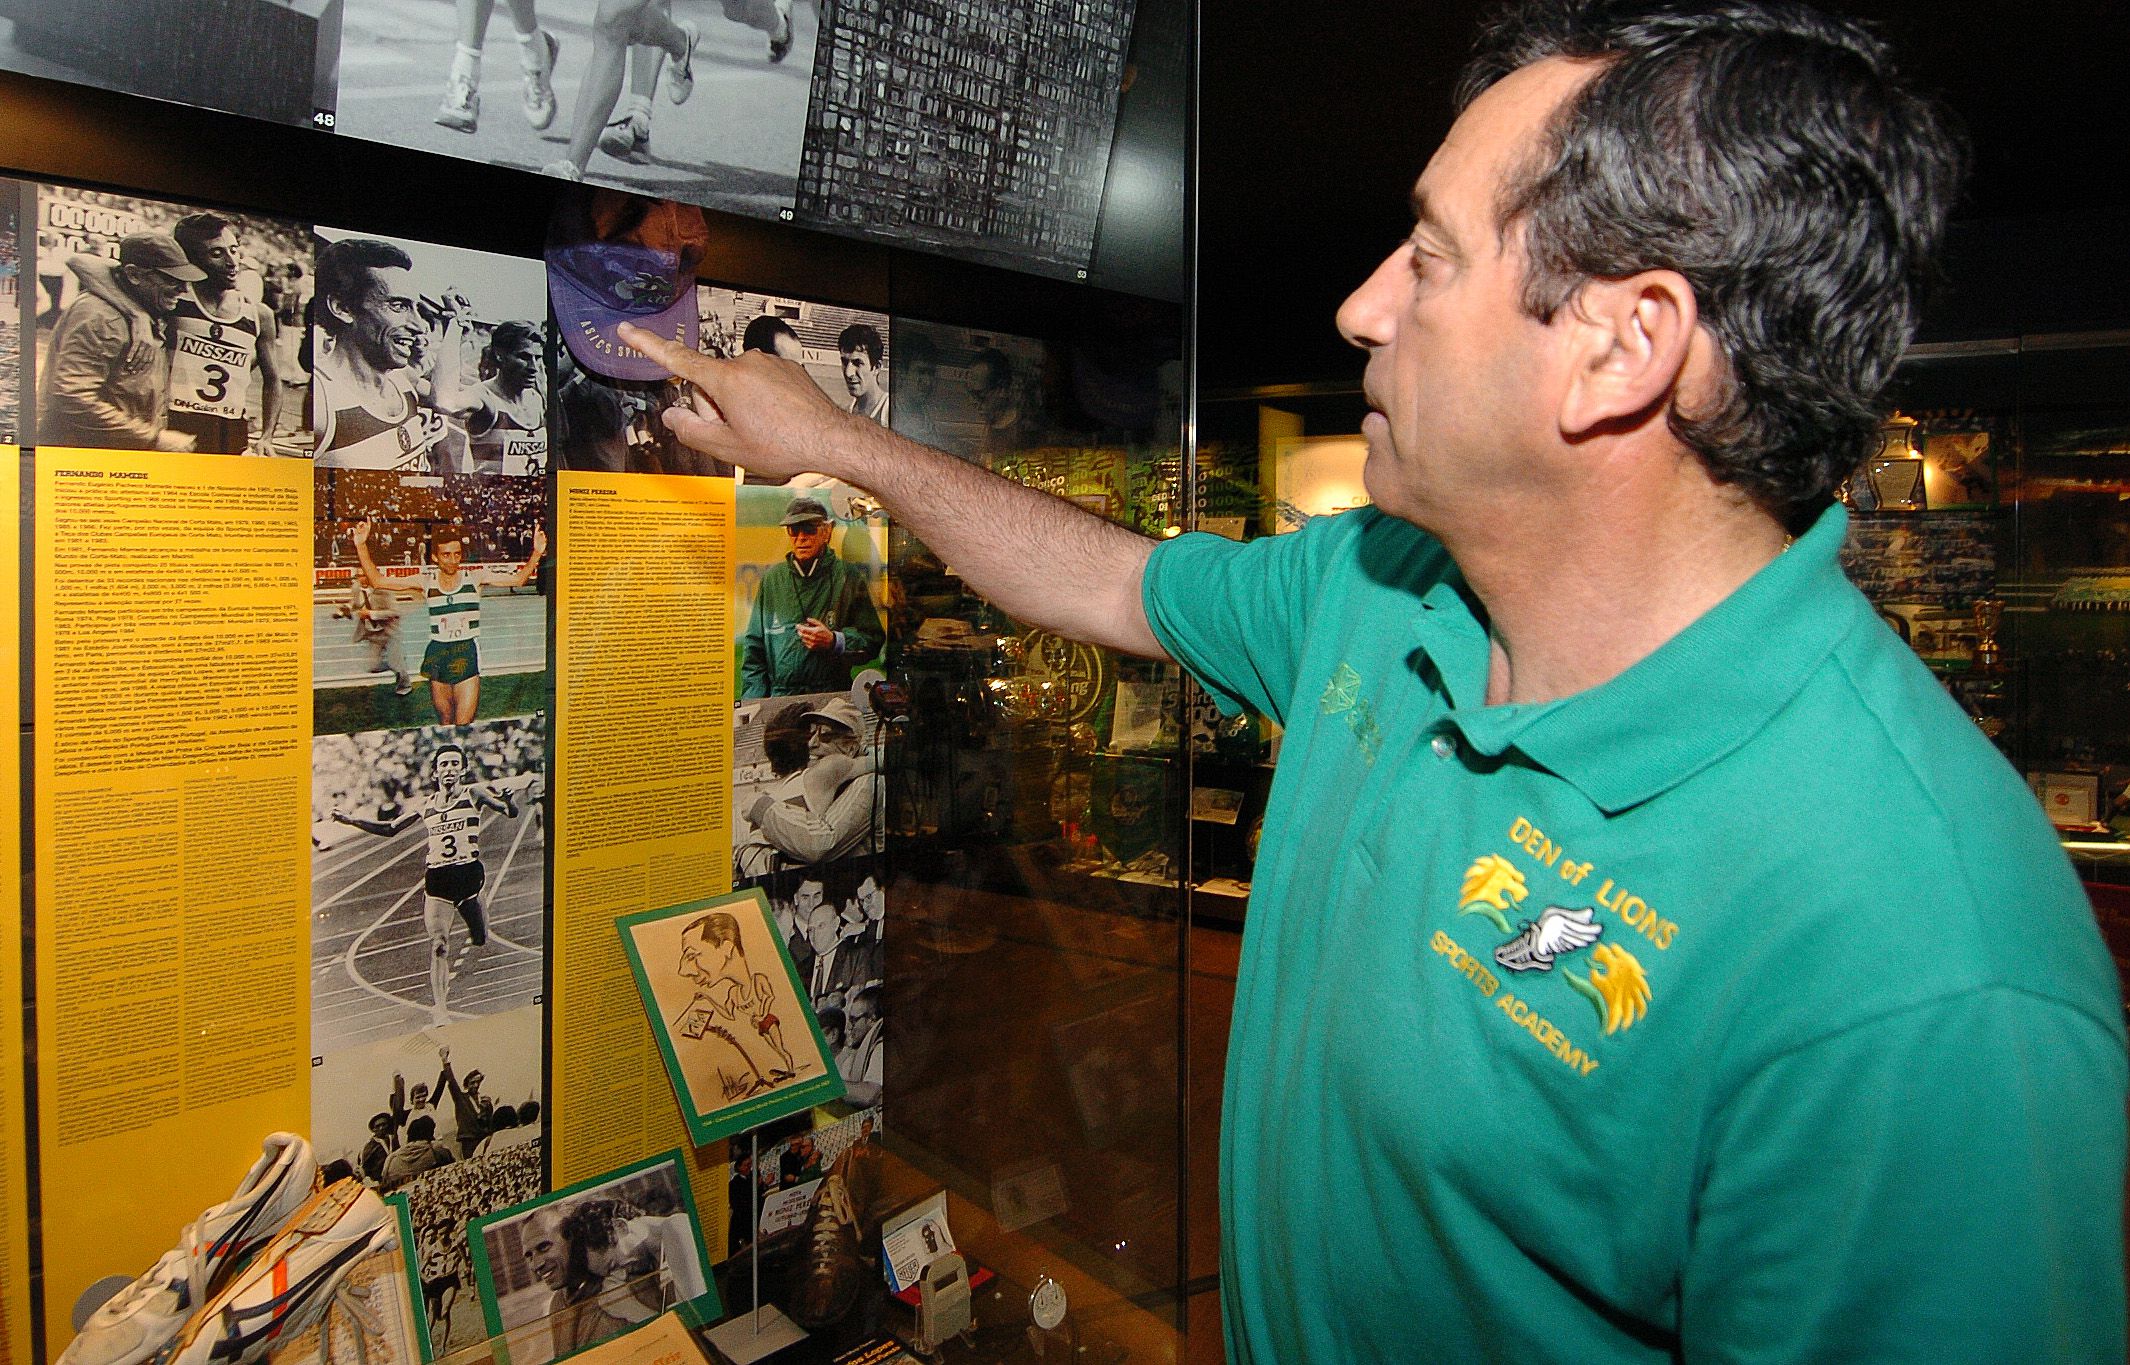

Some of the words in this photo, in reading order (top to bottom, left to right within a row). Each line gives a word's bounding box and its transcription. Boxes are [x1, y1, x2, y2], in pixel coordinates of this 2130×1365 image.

[314, 113, 334, 126] 48
[780, 209, 794, 221] 49
[580, 320, 612, 353] ASICS
[181, 337, 247, 367] NISSAN
[196, 364, 230, 402] 3
[508, 441, 547, 455] NISSA
[441, 835, 457, 857] 3
[1509, 816, 1562, 867] DEN
[1559, 861, 1594, 886] of
[1594, 879, 1680, 950] LIONS
[1430, 930, 1500, 997] SPORTS
[1496, 992, 1599, 1077] ACADEMY
